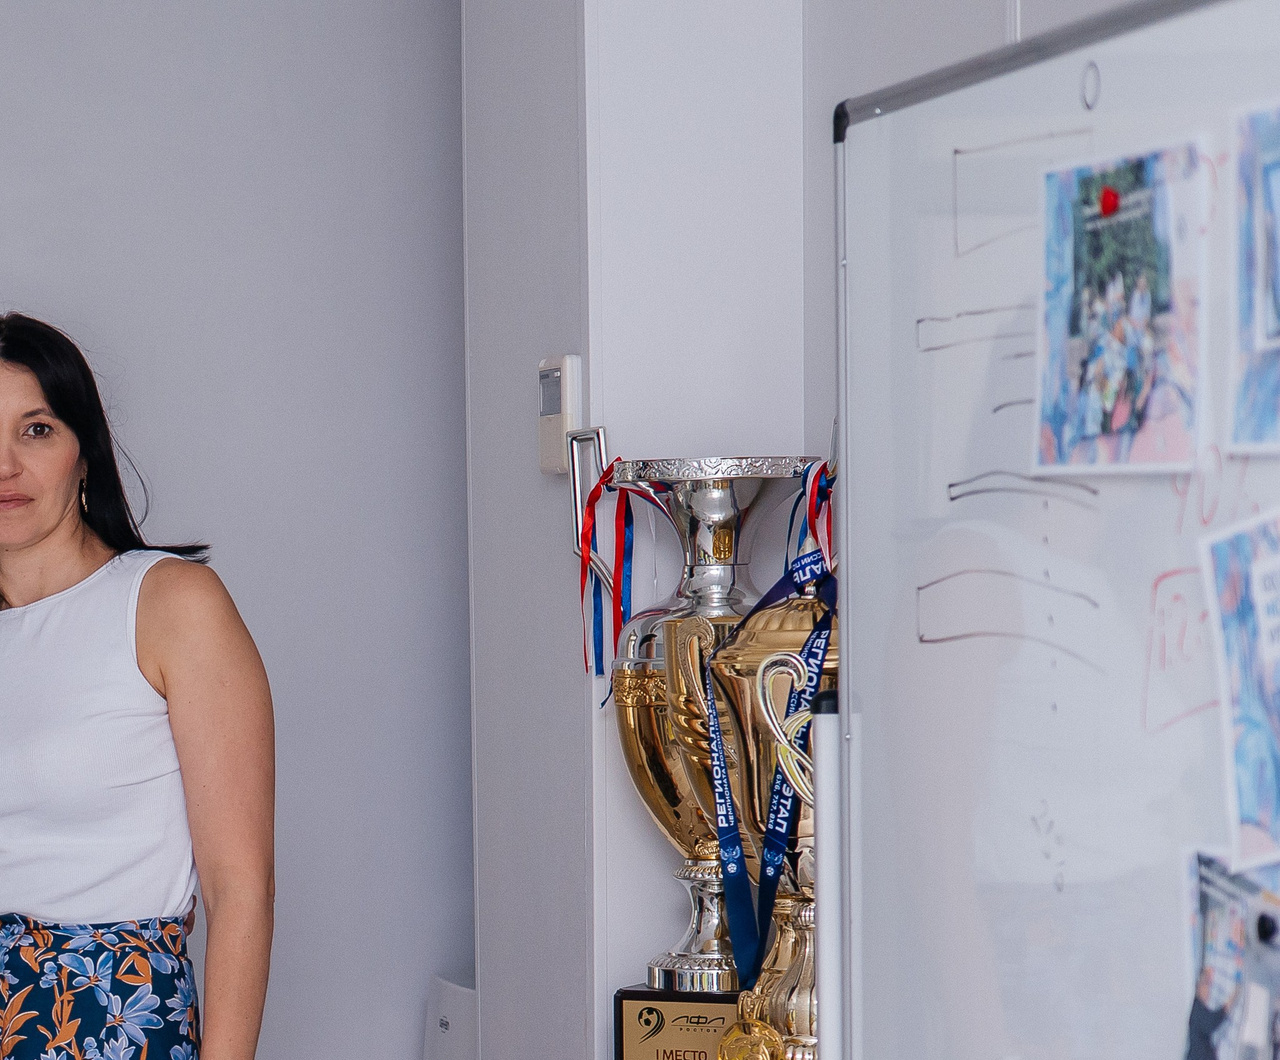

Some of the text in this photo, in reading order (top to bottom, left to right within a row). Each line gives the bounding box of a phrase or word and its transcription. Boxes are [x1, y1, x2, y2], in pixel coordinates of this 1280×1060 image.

[721, 767, 735, 827] ЧЕМПИОНАТА
[775, 783, 794, 834] ЭТАП
[671, 1014, 726, 1026] ЛФЛ
